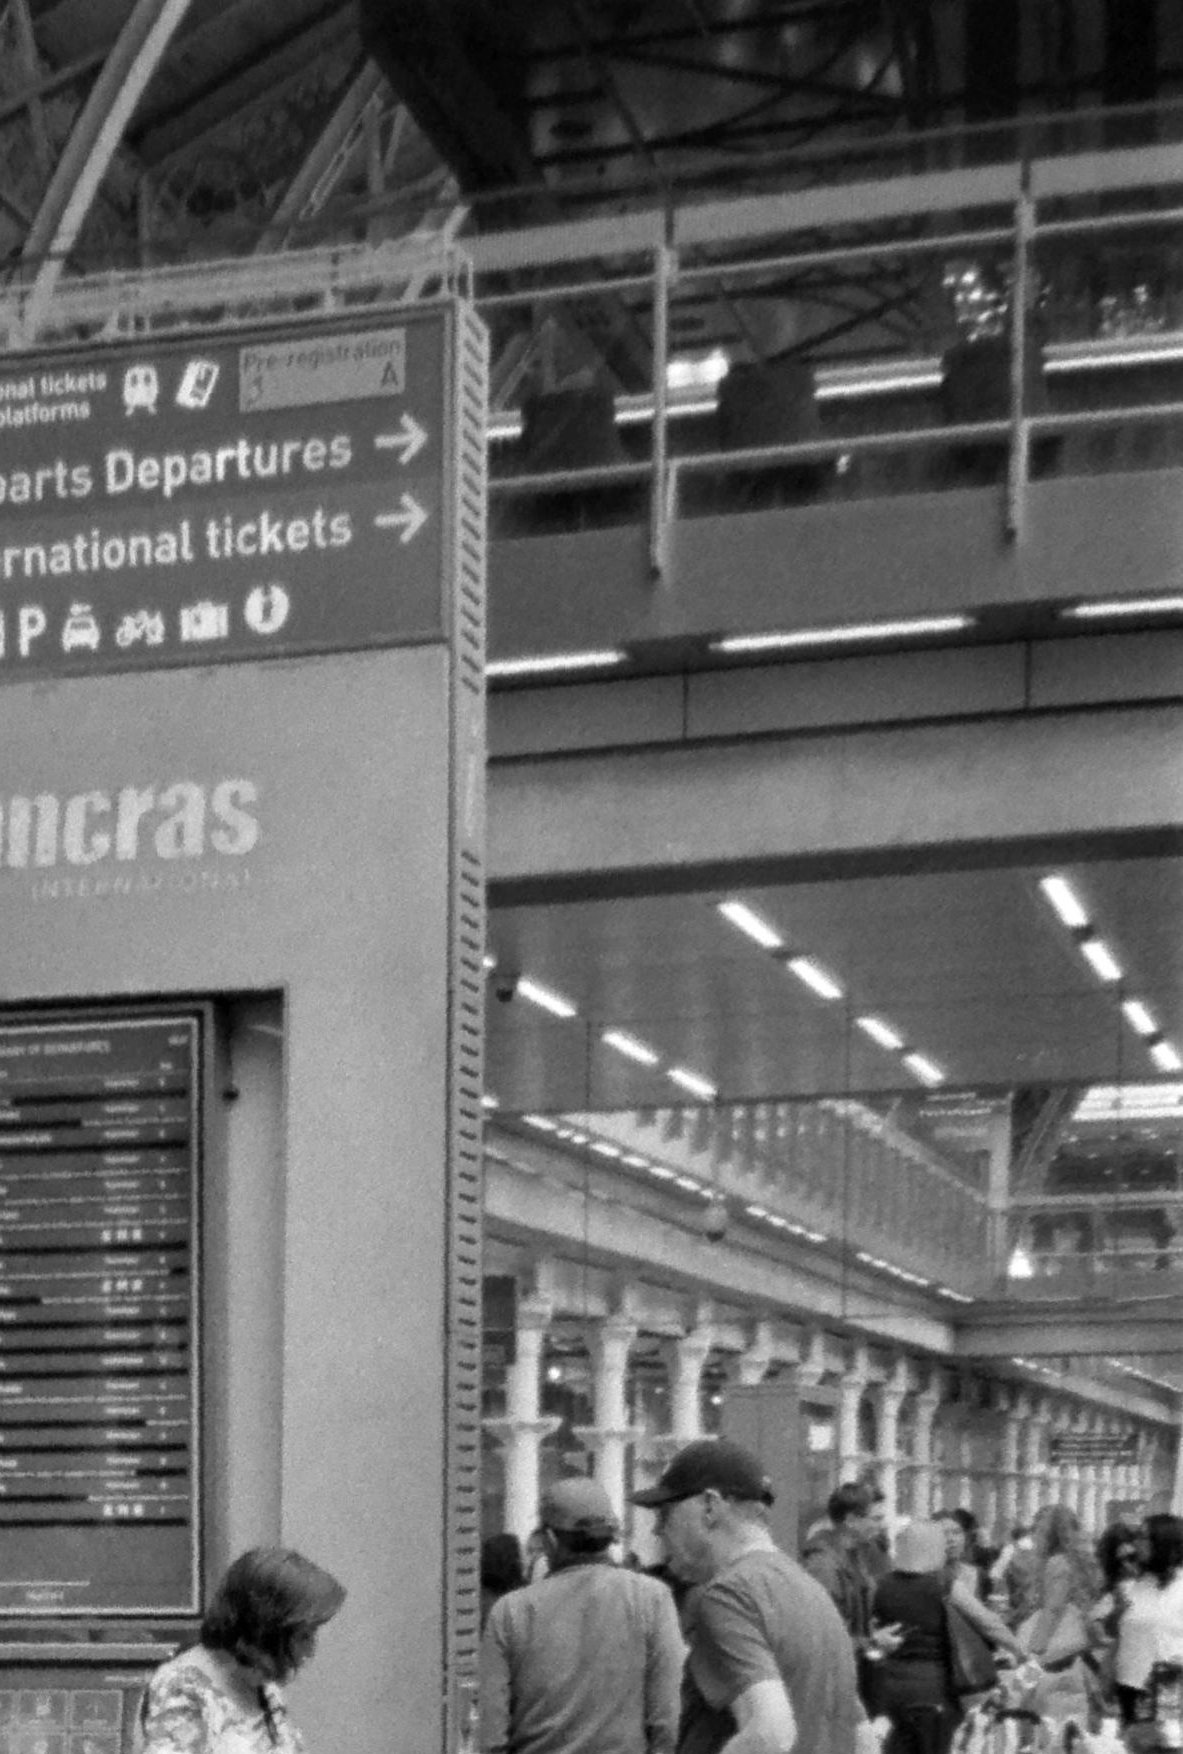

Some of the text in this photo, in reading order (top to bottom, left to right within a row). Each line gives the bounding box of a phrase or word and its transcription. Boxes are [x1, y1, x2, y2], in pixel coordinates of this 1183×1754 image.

[41, 370, 107, 396] tickets
[105, 432, 353, 502] Departures
[205, 507, 353, 560] tickets
